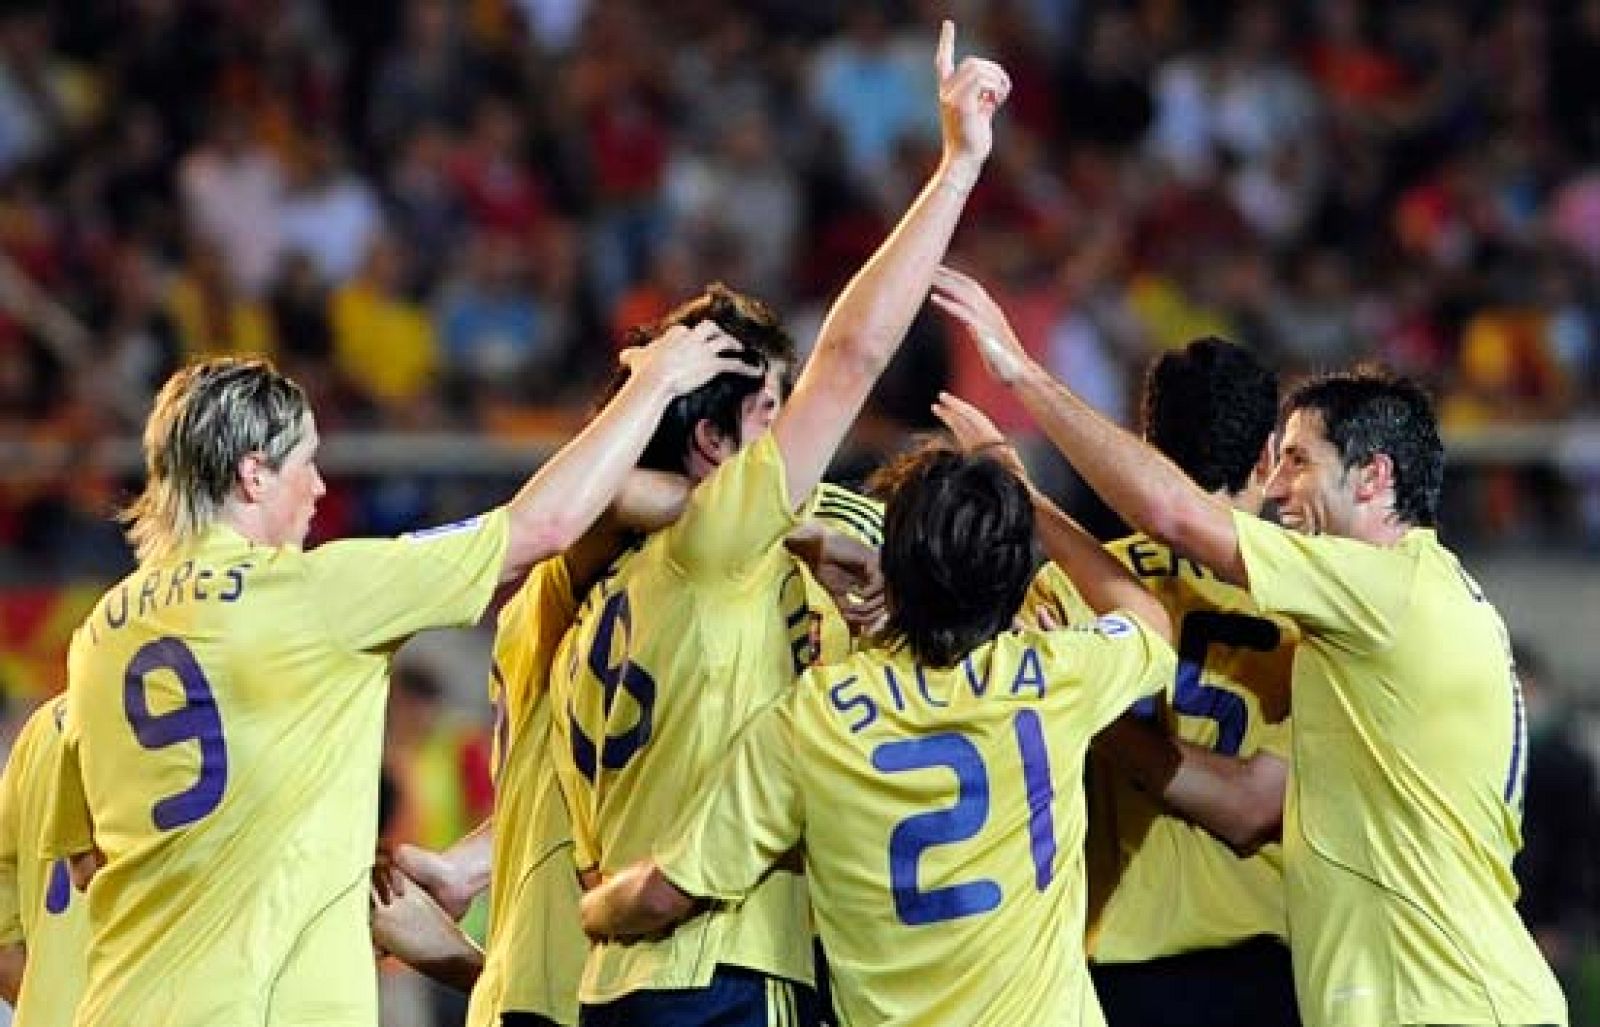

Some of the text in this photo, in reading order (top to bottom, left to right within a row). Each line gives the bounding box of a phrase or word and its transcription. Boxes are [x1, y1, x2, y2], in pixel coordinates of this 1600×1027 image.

[124, 637, 228, 832] 9
[829, 648, 1046, 733] SILVA
[871, 708, 1057, 926] 21
